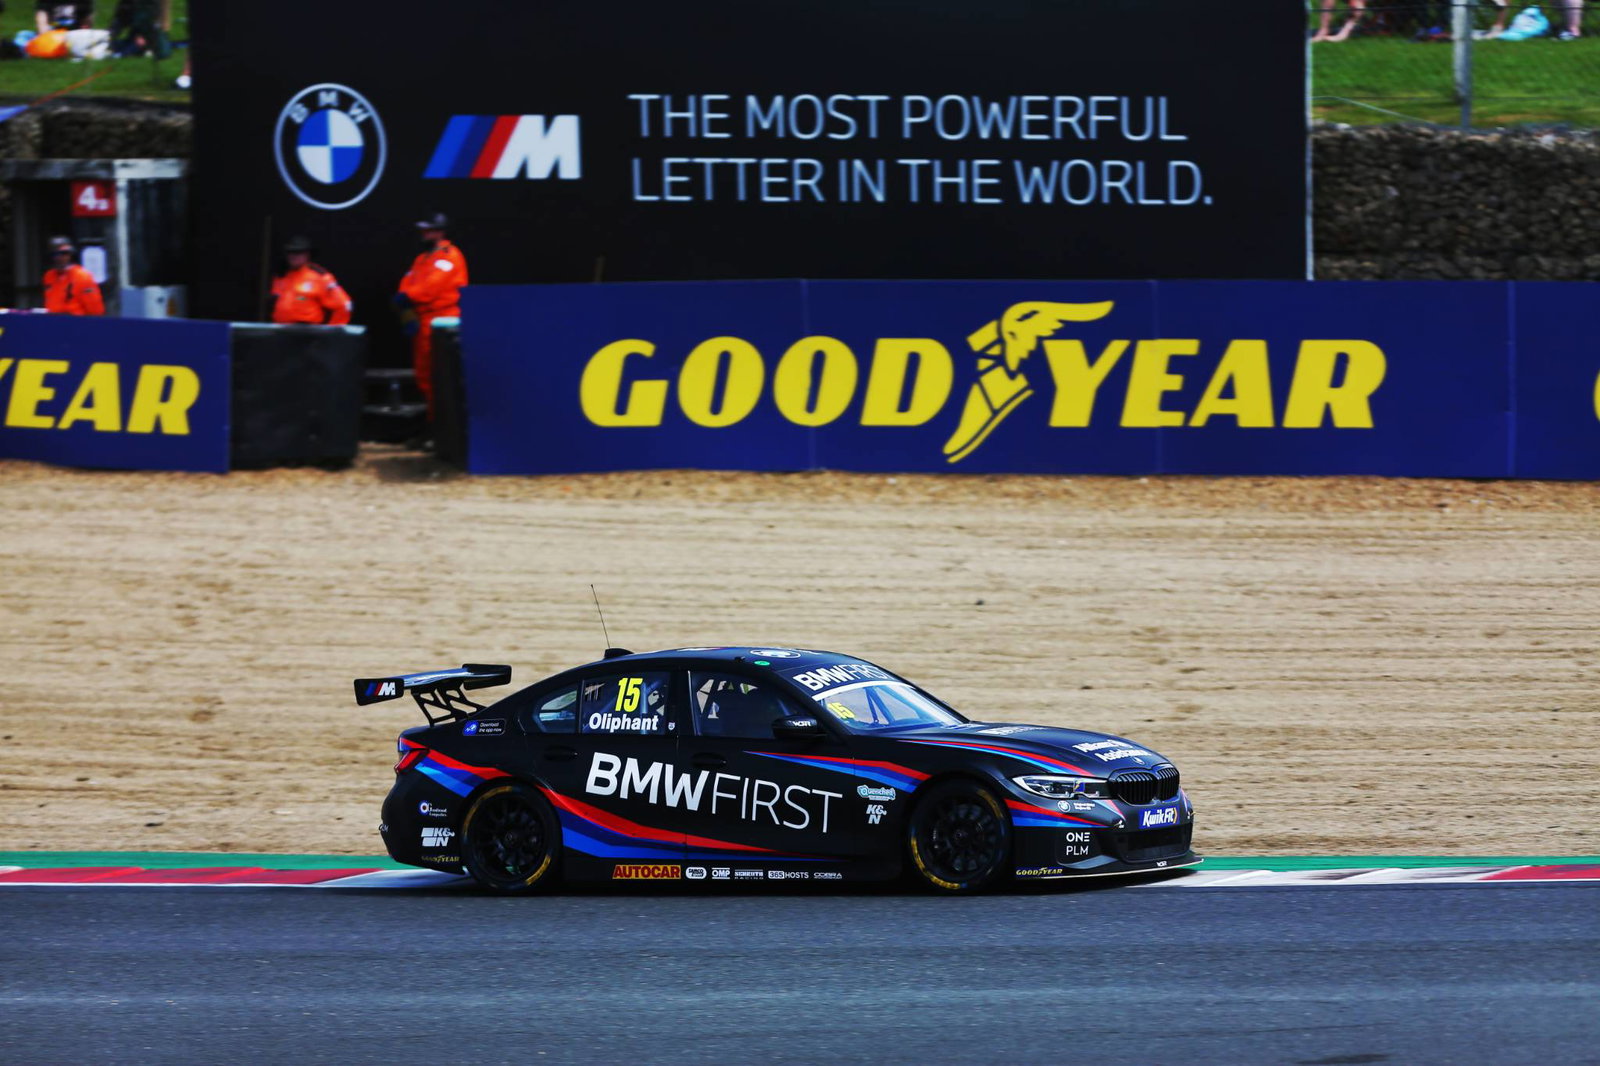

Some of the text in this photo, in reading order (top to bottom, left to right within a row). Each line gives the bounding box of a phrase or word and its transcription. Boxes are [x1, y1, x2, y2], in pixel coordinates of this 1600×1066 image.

[287, 90, 370, 124] BMW
[628, 94, 1187, 142] THE MOST POWERFUL
[492, 114, 581, 180] M
[632, 158, 1213, 206] LETTER IN THE WORLD.
[0, 357, 200, 435] EAR
[377, 681, 396, 696] M
[615, 677, 644, 712] 15
[827, 702, 856, 719] 15
[588, 712, 659, 733] Oliphant
[1065, 831, 1091, 842] ONE
[1065, 845, 1089, 856] PLM
[613, 865, 681, 878] AUTOCAR
[712, 869, 731, 878] OMP
[1016, 868, 1063, 876] GOODYEAR
